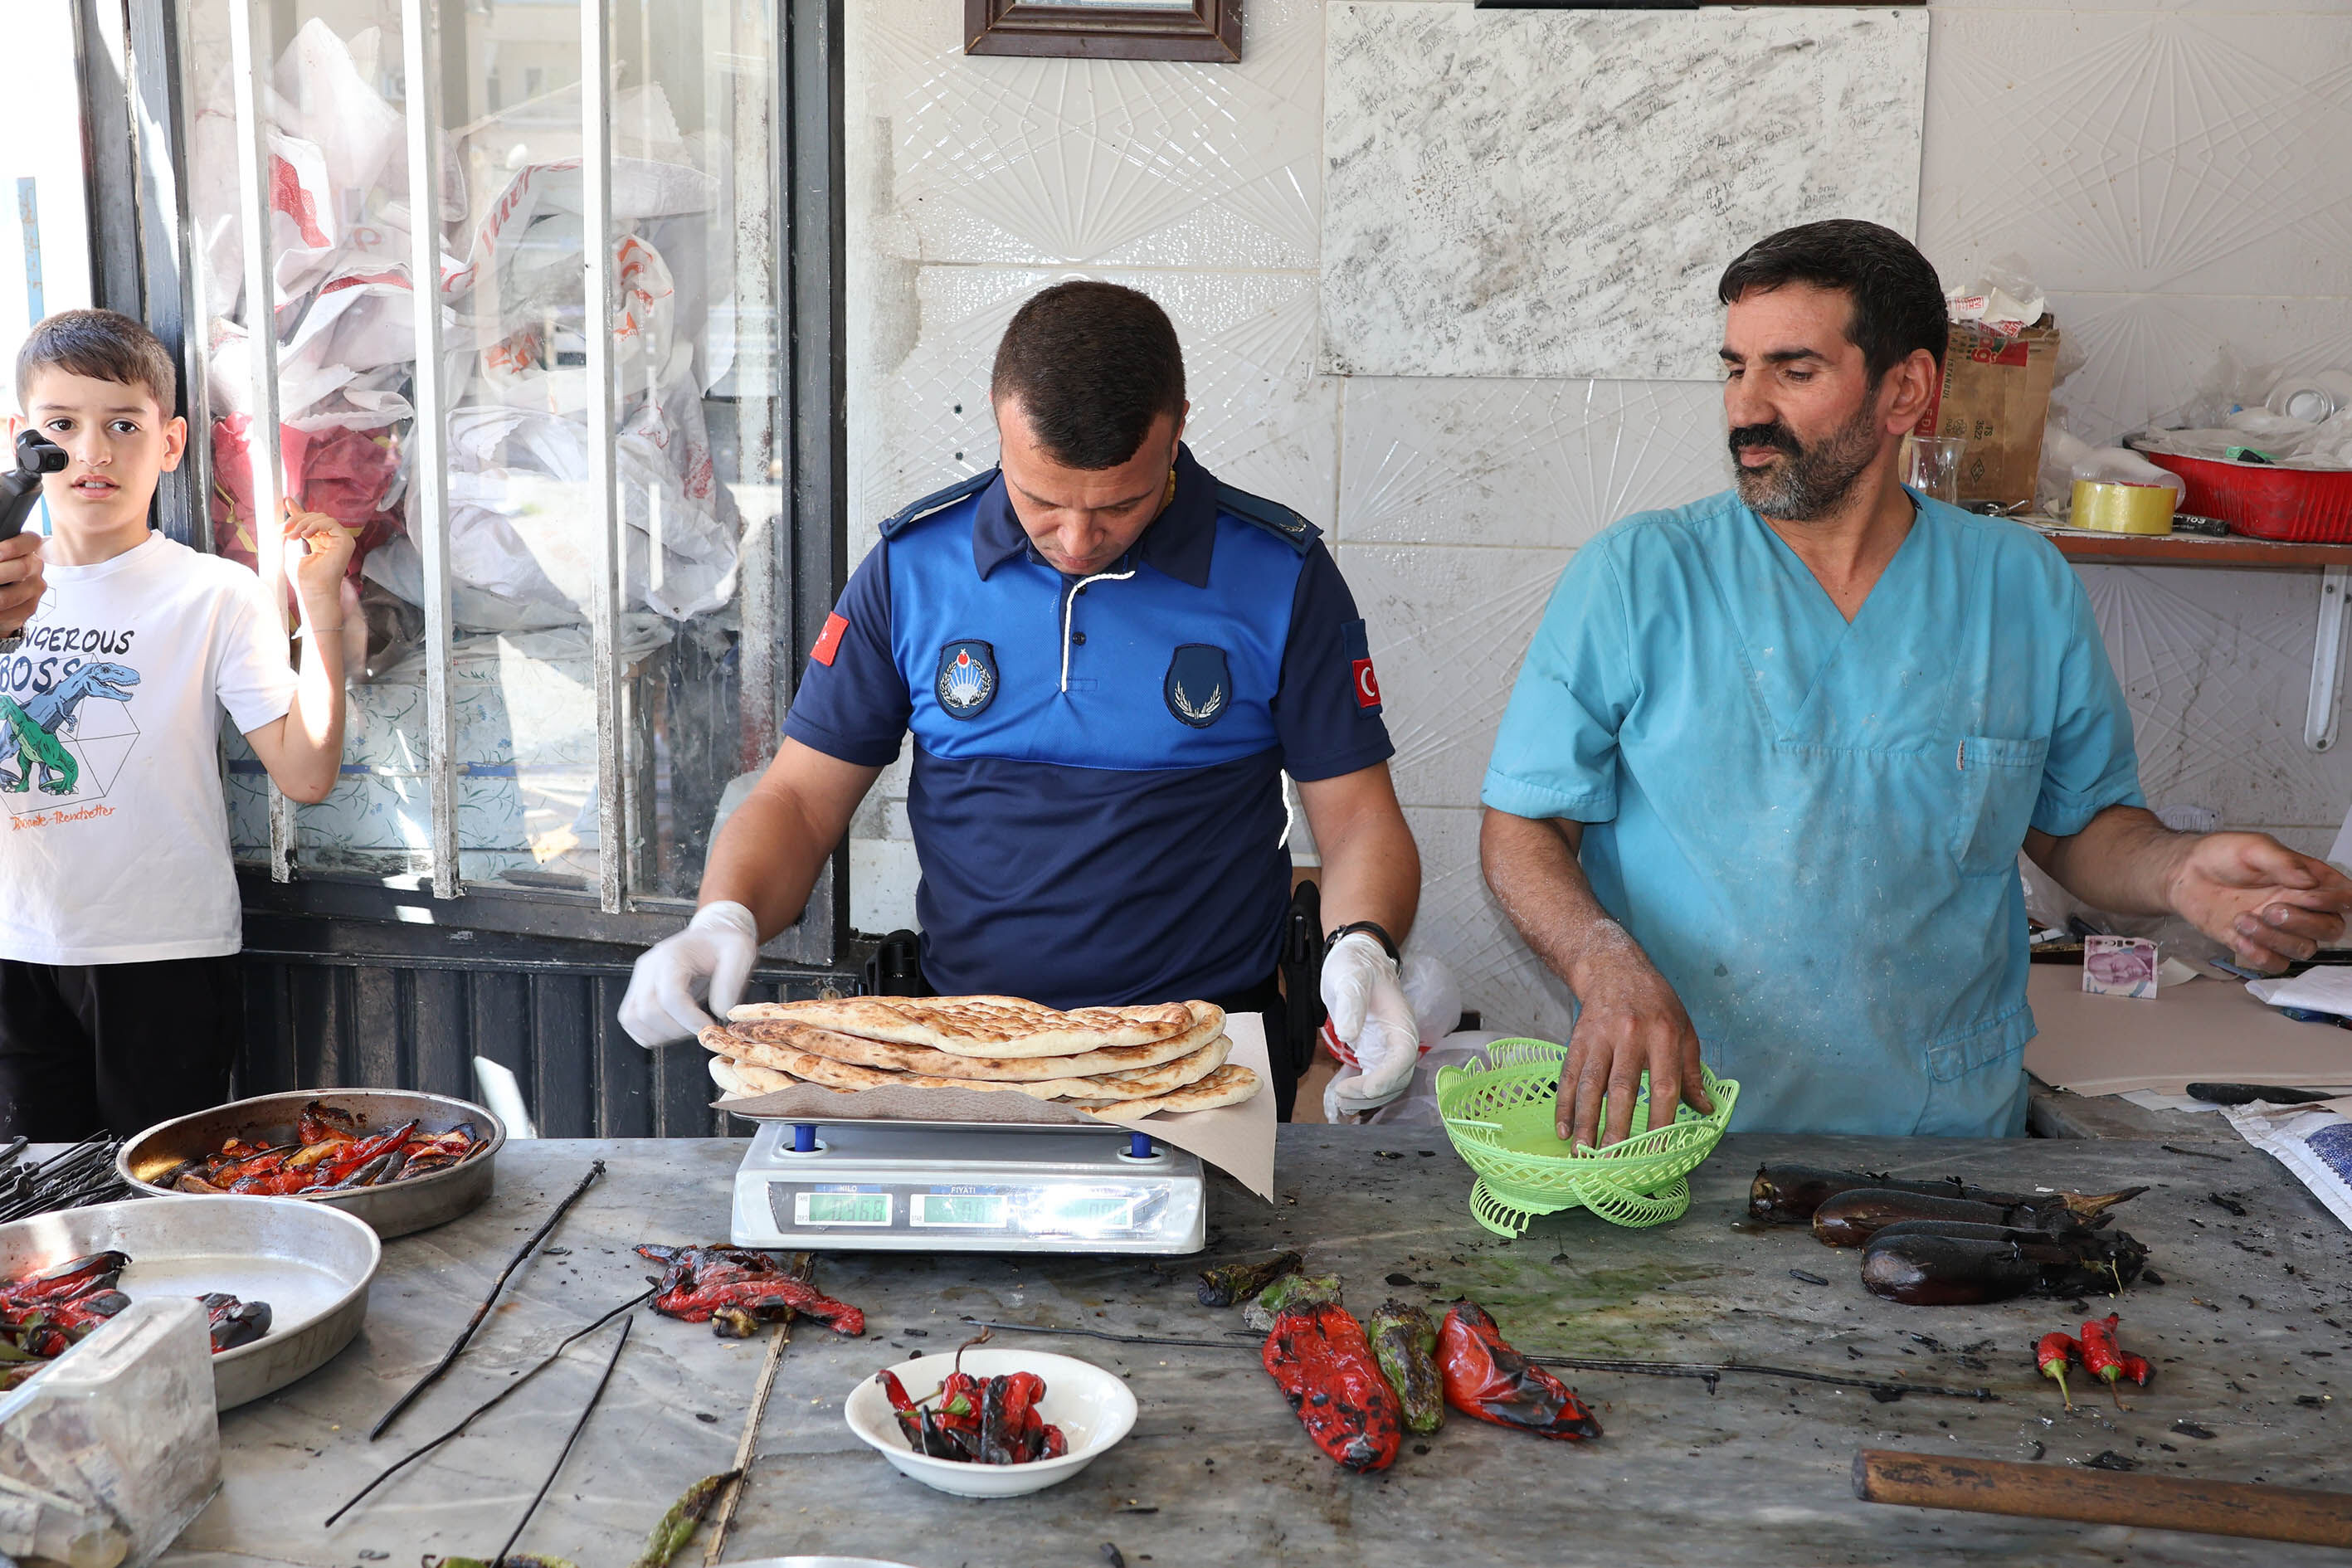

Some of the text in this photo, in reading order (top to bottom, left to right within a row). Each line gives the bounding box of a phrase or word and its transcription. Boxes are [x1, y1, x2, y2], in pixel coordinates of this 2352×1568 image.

[1975, 420, 1984, 440] 3522
[1984, 426, 1994, 436] TS
[2186, 516, 2207, 524] 103
[26, 626, 135, 655] NGEROUS
